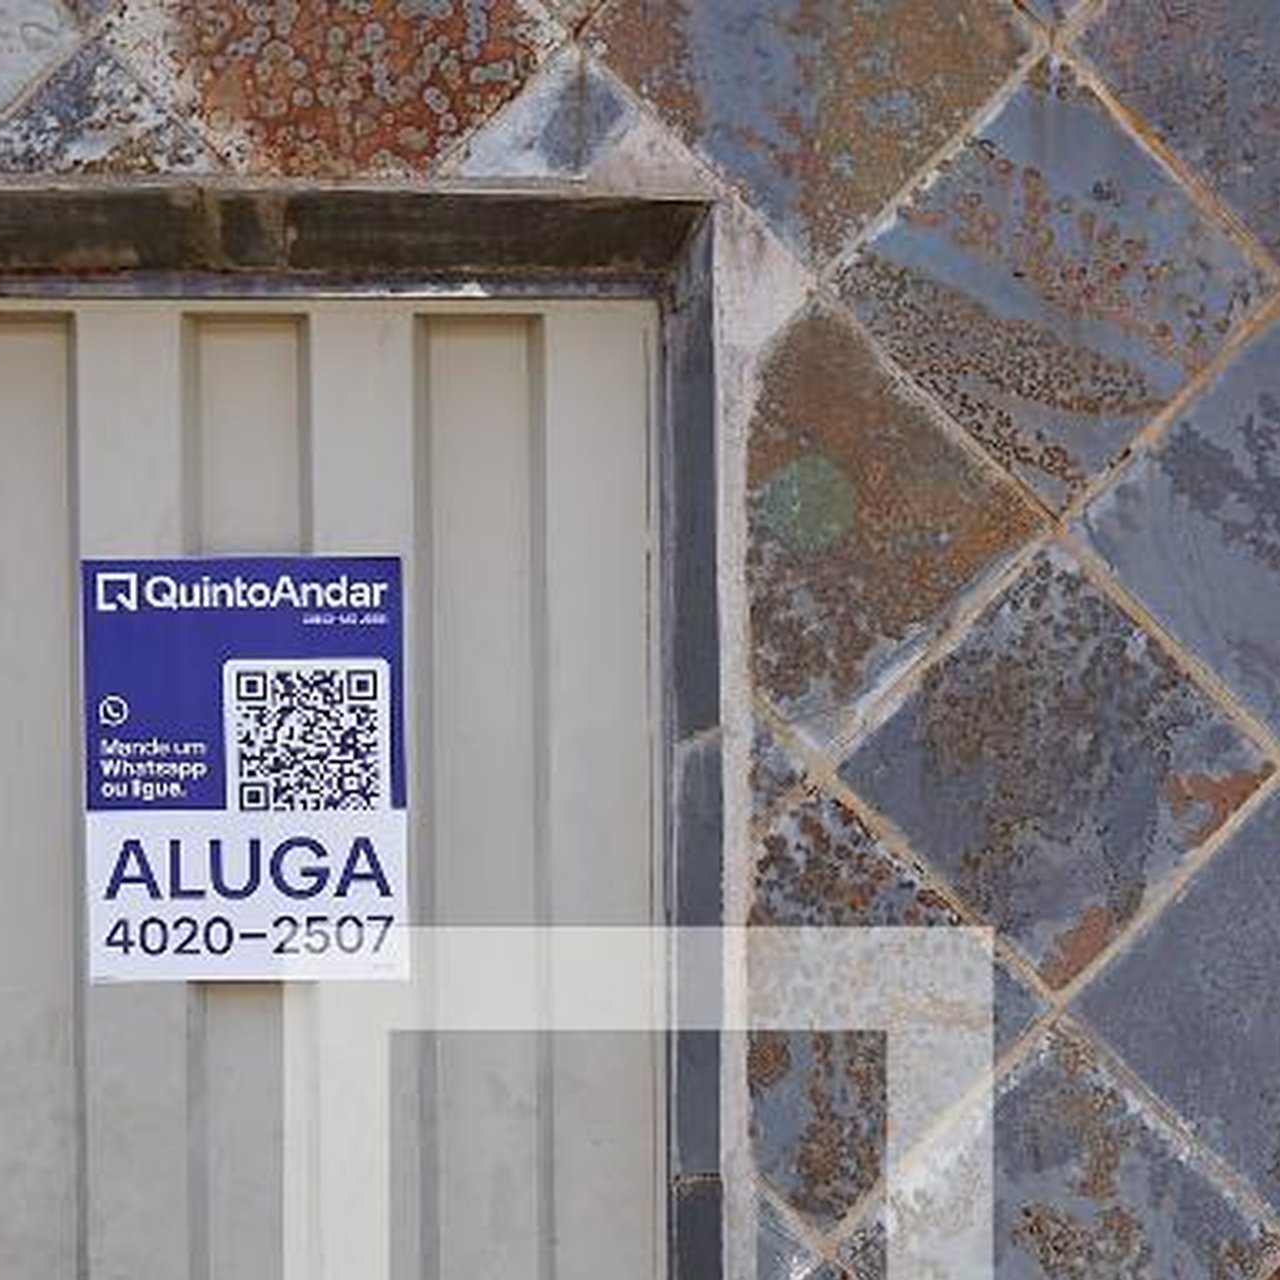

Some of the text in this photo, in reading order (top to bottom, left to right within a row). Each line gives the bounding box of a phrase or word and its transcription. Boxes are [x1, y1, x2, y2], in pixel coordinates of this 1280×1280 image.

[144, 574, 388, 610] QuintoAndar
[102, 783, 128, 797] ou
[104, 837, 393, 901] ALUGA
[104, 915, 395, 956] 4020-2507
